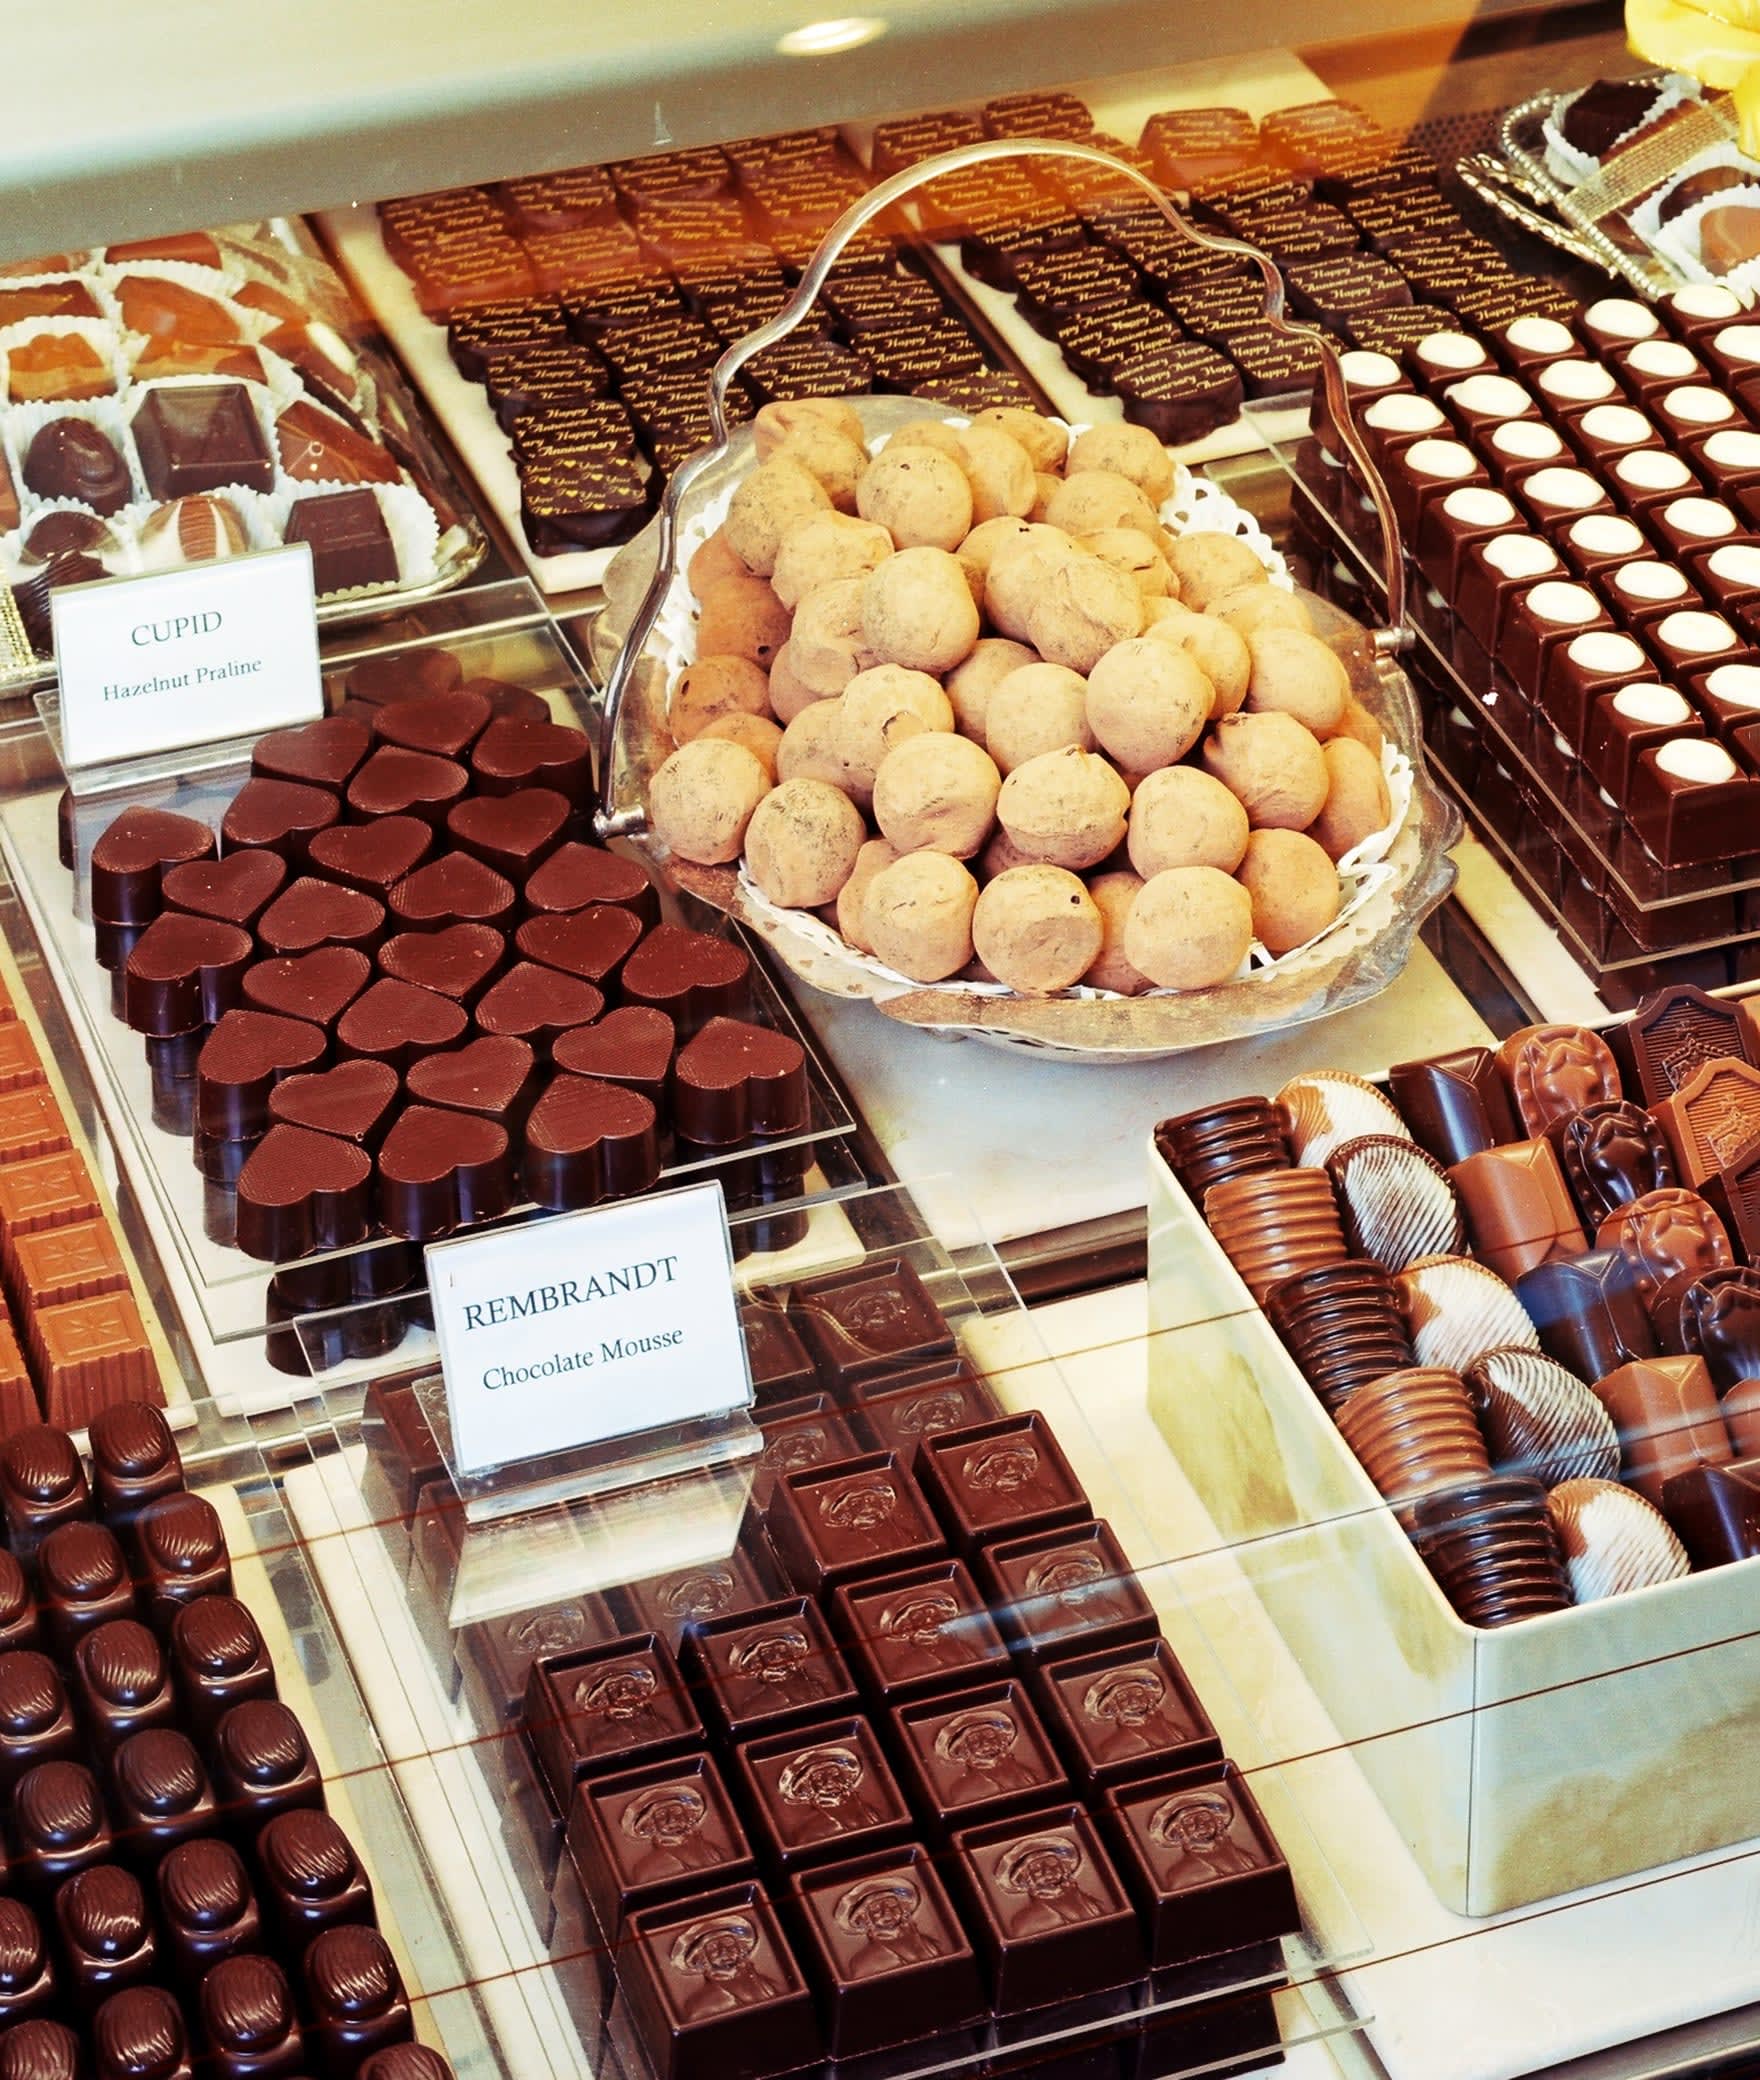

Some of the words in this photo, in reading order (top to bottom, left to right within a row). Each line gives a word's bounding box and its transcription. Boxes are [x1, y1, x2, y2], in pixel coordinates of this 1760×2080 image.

[1281, 242, 1321, 253] Happy
[1417, 257, 1455, 266] Happy
[1059, 270, 1100, 280] Happy
[1310, 268, 1351, 279] Happy
[1302, 274, 1374, 293] Anniversary
[1427, 278, 1469, 288] Happy
[1203, 287, 1243, 297] Happy
[1330, 287, 1372, 299] Happy
[1219, 306, 1259, 316] Happy
[1475, 305, 1516, 321] Happy
[1100, 323, 1173, 349] Anniversary
[885, 338, 927, 348] Happy
[656, 350, 698, 364] Happy
[900, 359, 941, 371] Happy
[1130, 370, 1171, 387] Happy
[804, 384, 846, 393] Happy
[546, 408, 589, 417] Happy
[556, 431, 599, 440] Happy
[538, 441, 617, 456] Anniversary
[131, 610, 223, 647] CUPID
[103, 673, 190, 701] Hazelnut
[196, 659, 262, 684] Praline
[462, 1255, 678, 1332] REMBRANDT
[482, 1349, 595, 1391] Chocolate
[600, 1328, 684, 1364] Mousse
